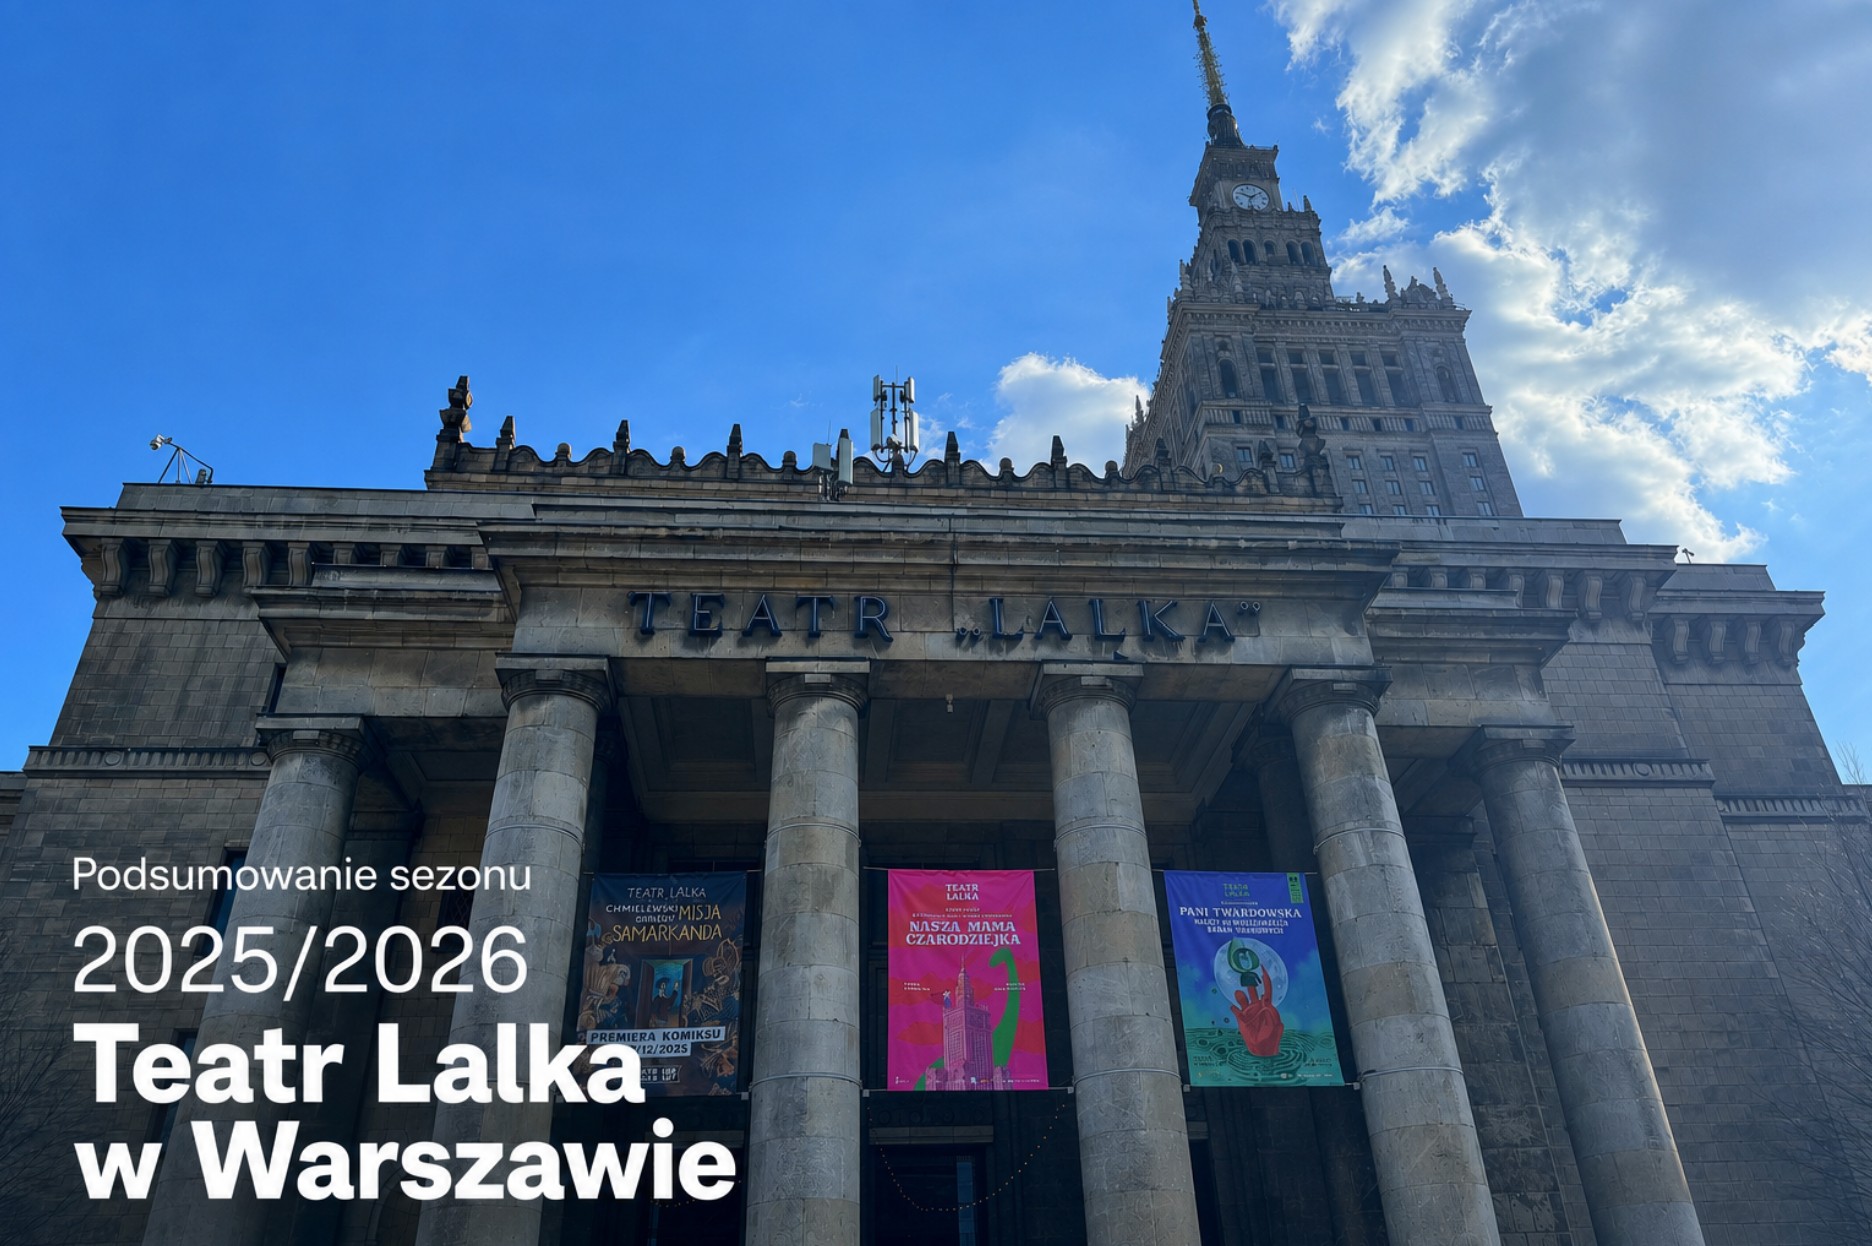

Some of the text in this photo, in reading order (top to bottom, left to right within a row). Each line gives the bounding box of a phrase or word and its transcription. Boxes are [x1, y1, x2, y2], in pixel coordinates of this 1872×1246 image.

[627, 591, 894, 642] TEATR
[628, 886, 707, 899] TEATR LALKA
[945, 884, 979, 892] TEATR
[946, 892, 979, 901] LALKA
[678, 904, 722, 921] MISJA
[1179, 906, 1302, 918] PANI TWARDOWSKA
[909, 920, 1016, 932] NASZA MAMA
[613, 924, 722, 942] SAMARKANDA
[905, 933, 1021, 946] CZARODZIEJKA
[591, 1029, 721, 1042] PREMIERA KOMIKSU
